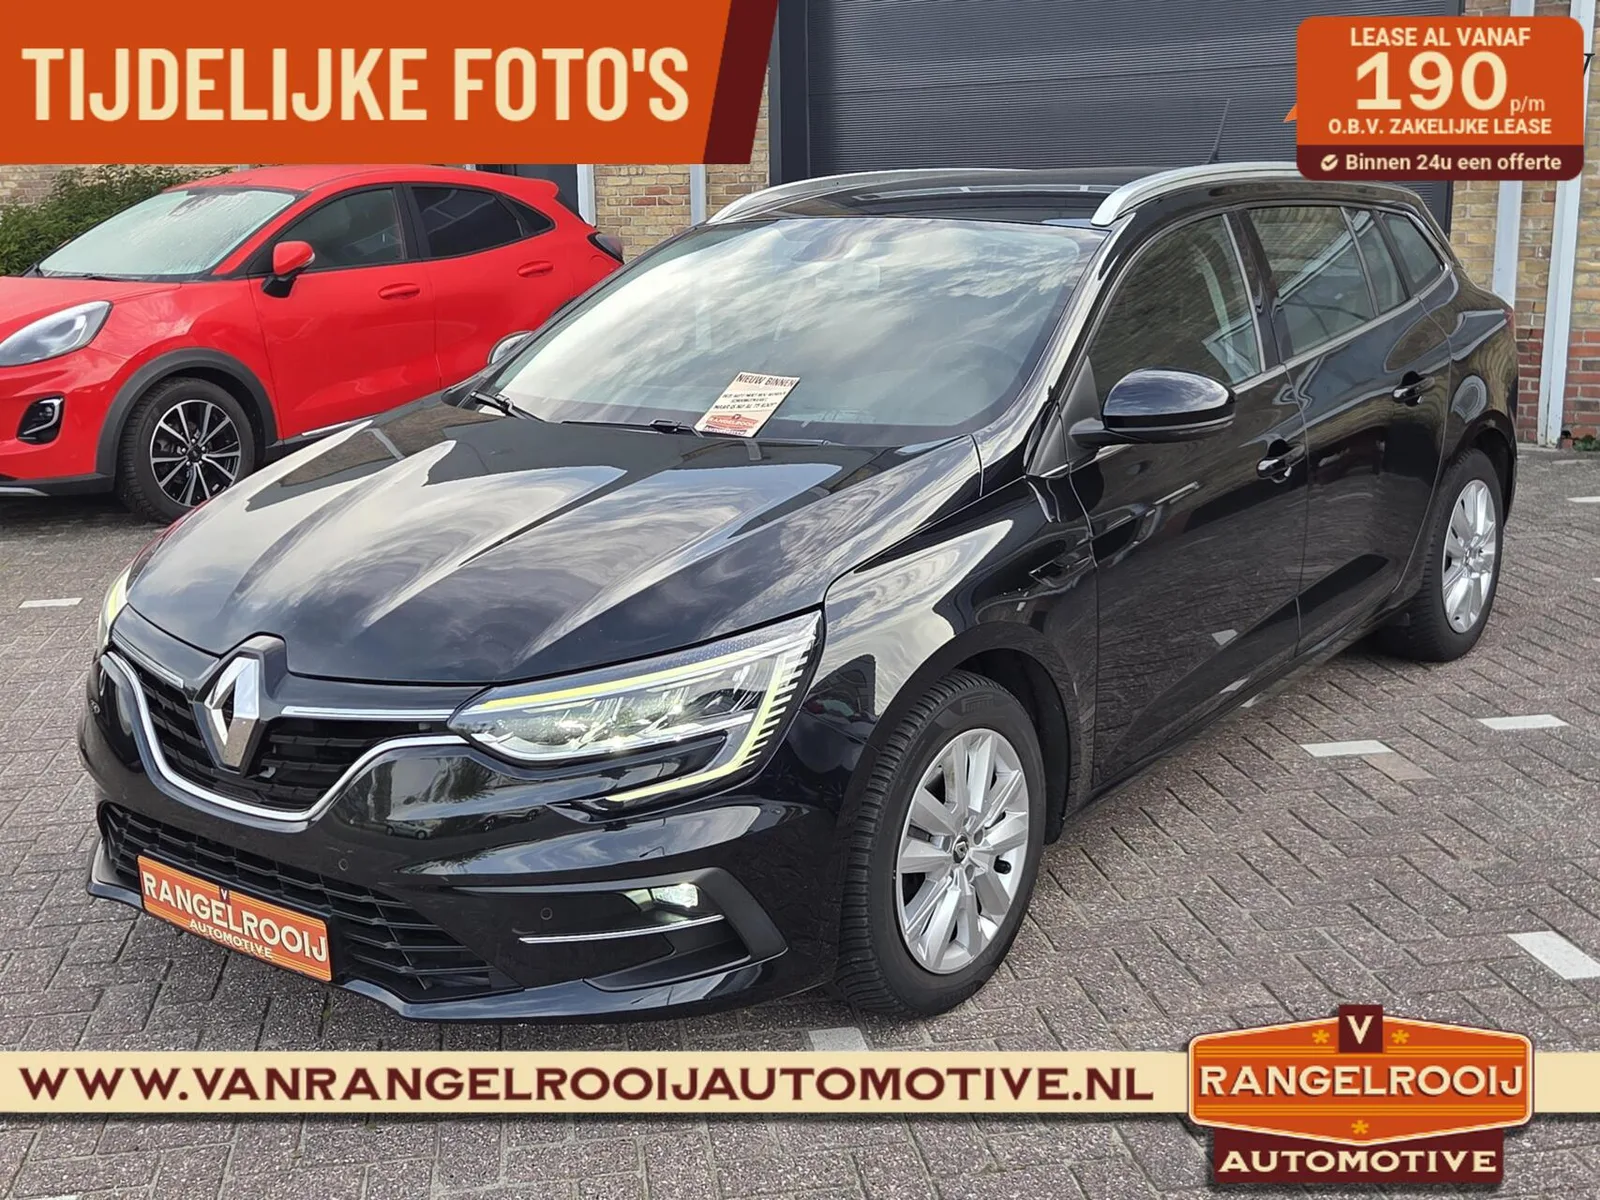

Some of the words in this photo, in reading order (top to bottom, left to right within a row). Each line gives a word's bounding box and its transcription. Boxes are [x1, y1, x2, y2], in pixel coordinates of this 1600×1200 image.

[737, 373, 765, 385] NIEUW
[765, 376, 798, 387] BINNEN
[142, 870, 327, 963] RANGELROOIJ
[188, 918, 273, 959] AUTOMOTIVE
